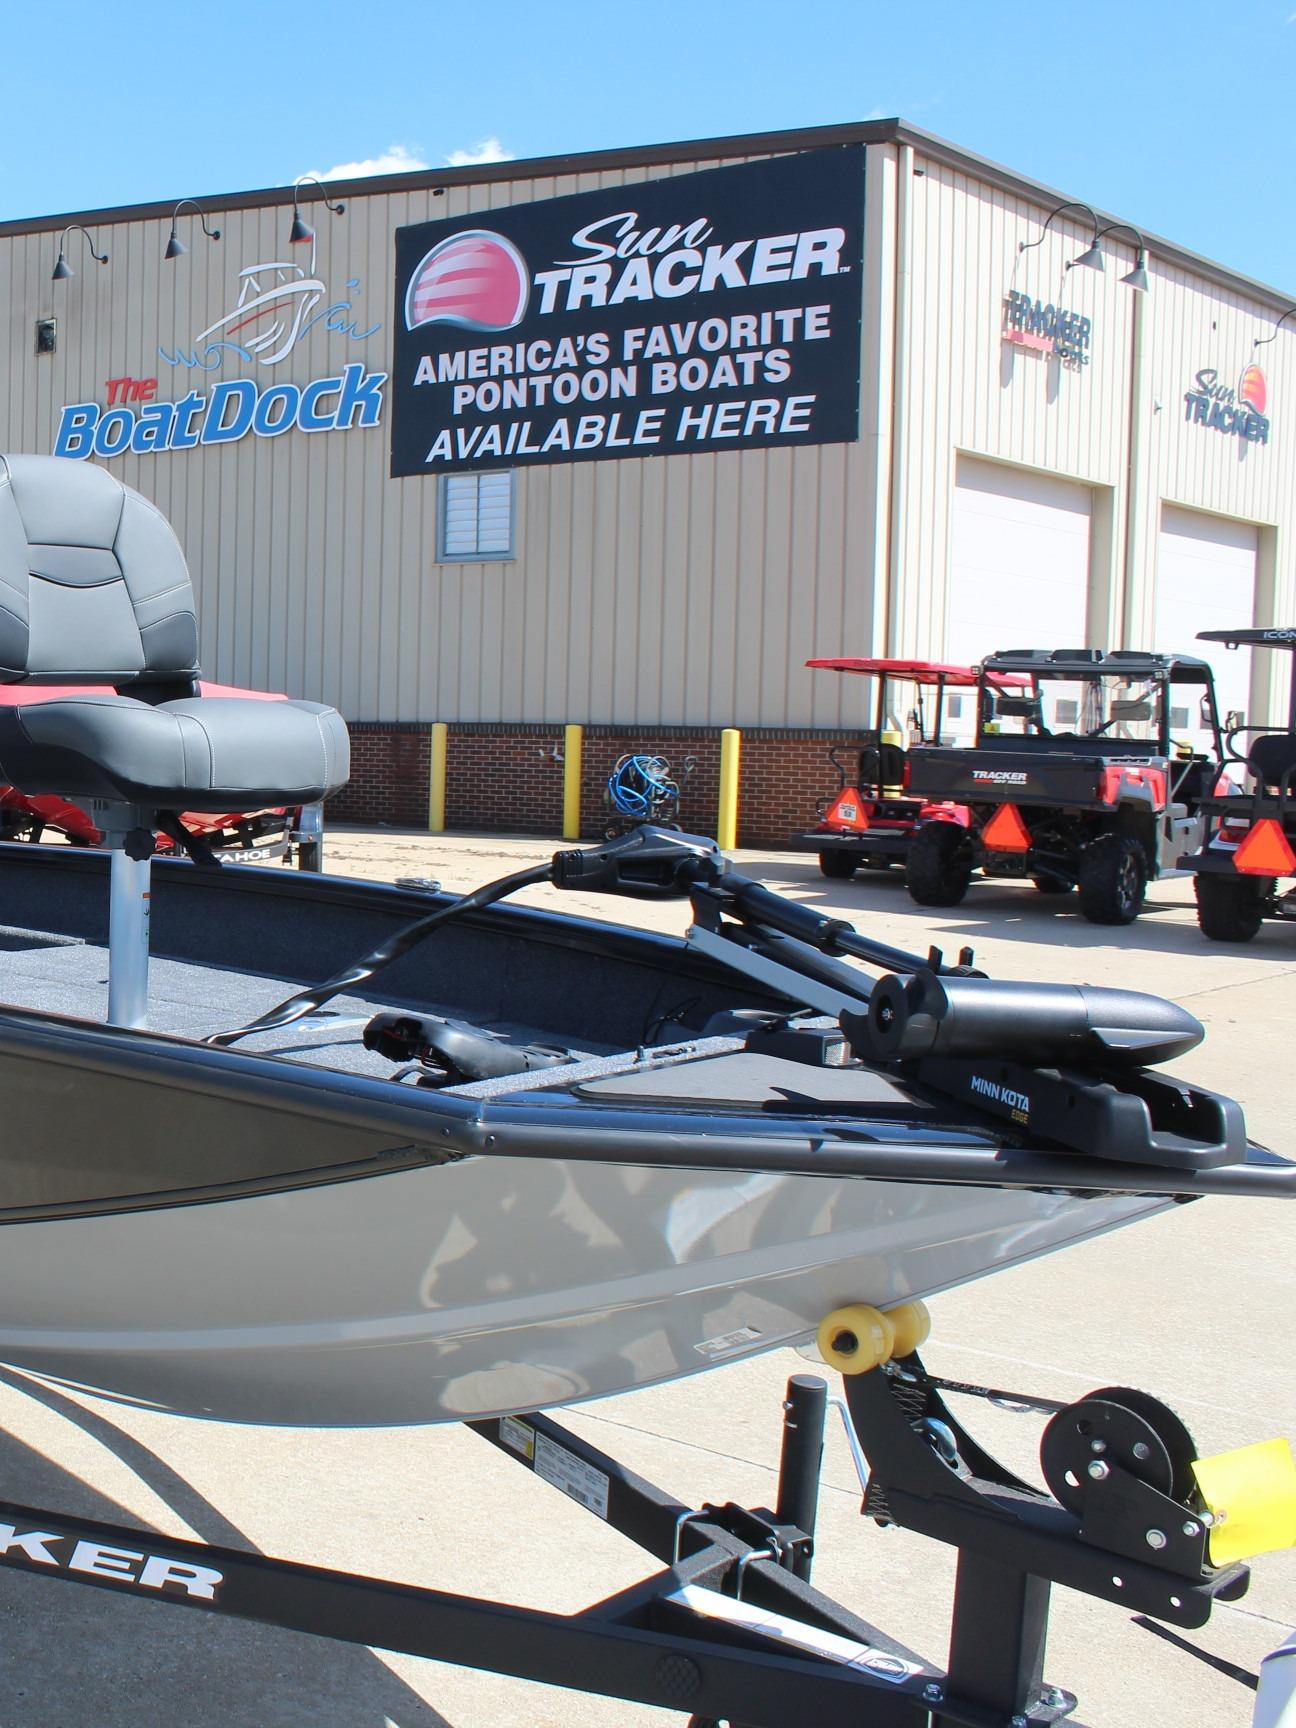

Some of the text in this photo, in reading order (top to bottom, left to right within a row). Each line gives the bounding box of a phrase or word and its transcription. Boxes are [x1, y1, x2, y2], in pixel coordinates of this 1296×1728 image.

[553, 211, 714, 266] Sun
[533, 227, 846, 315] TRACKER
[413, 304, 831, 387] AMERICA'S FAVORITE
[105, 376, 158, 405] The
[452, 348, 792, 416] PONTOON BOATS
[1190, 368, 1235, 406] Sun
[425, 394, 817, 463] AVAILABLE HERE
[1185, 392, 1270, 445] TRACKER
[972, 770, 1028, 780] TRACKER
[971, 1075, 1030, 1113] MINN KOTA
